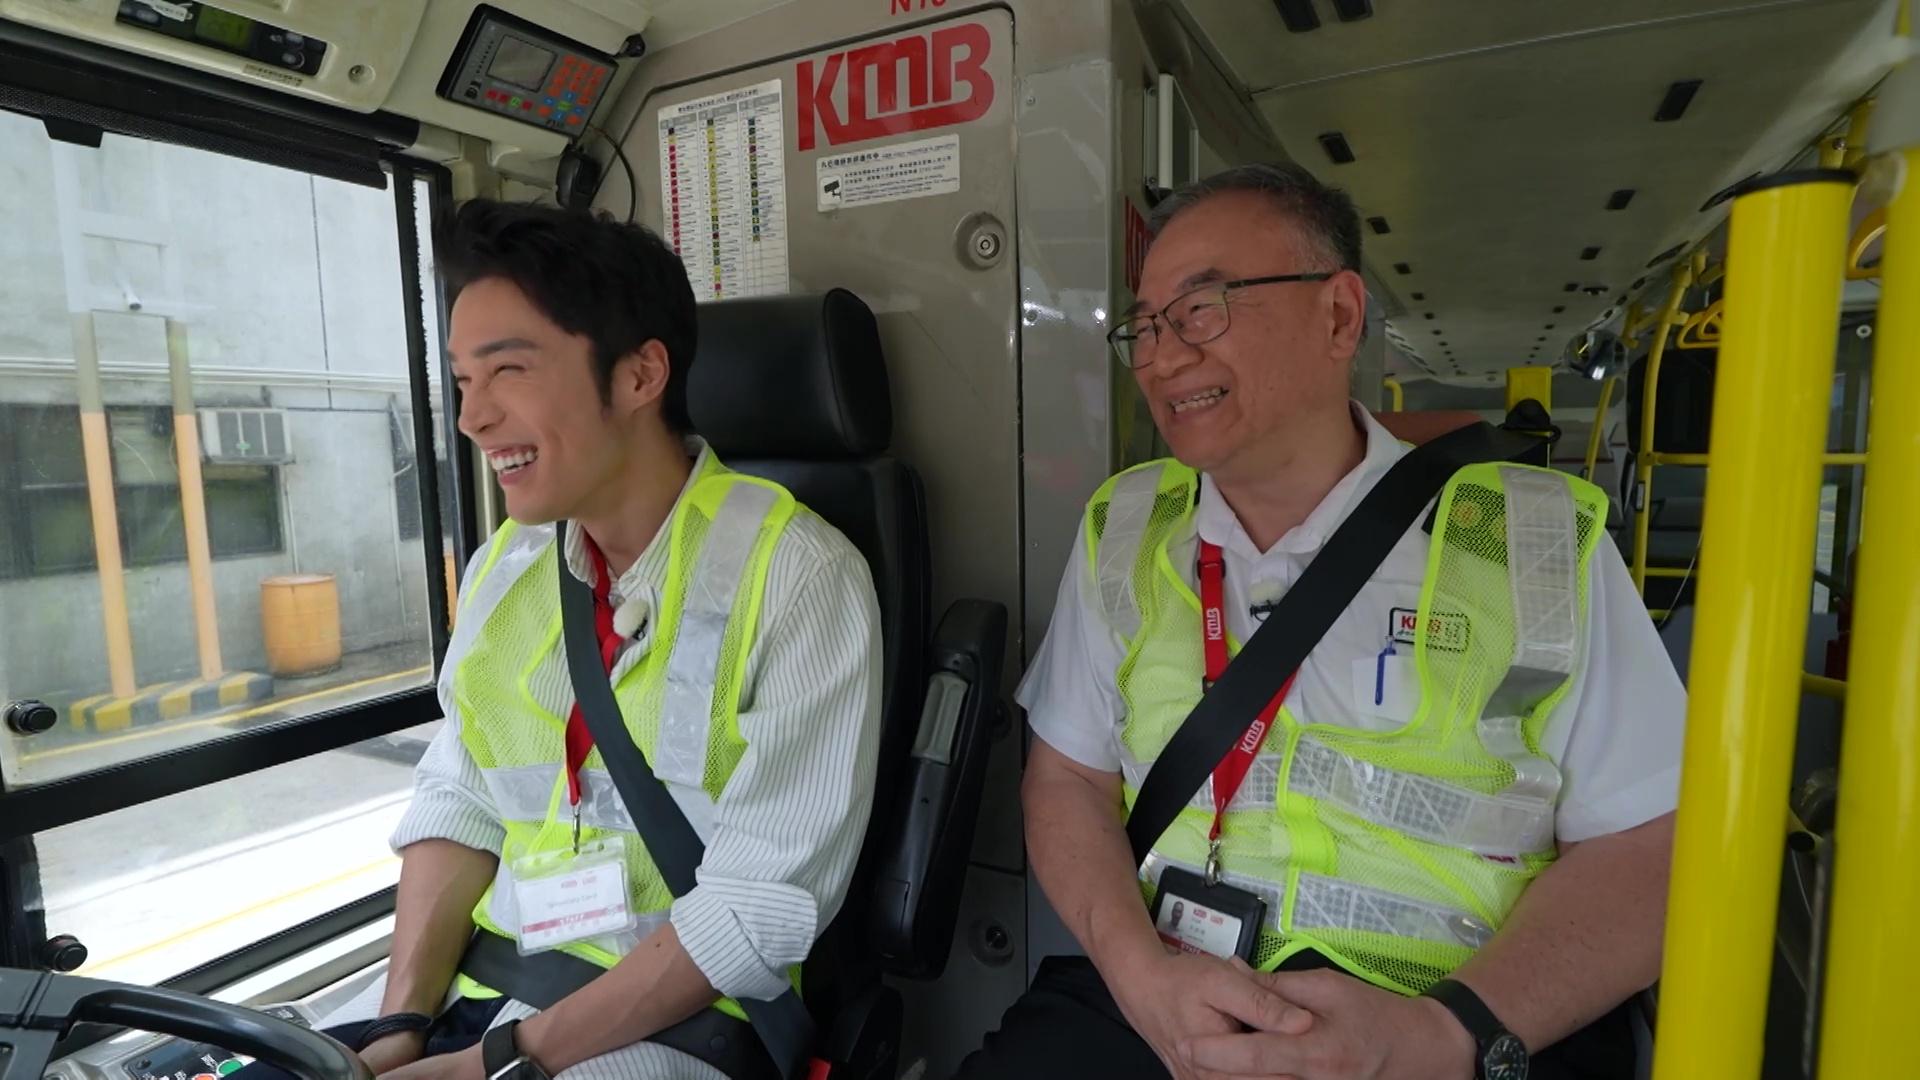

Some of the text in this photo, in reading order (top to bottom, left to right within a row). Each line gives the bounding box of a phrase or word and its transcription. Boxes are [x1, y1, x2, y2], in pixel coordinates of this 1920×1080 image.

[797, 23, 995, 151] KMB
[1207, 607, 1222, 641] KMB
[1401, 615, 1441, 633] KB
[1240, 719, 1266, 754] KMB
